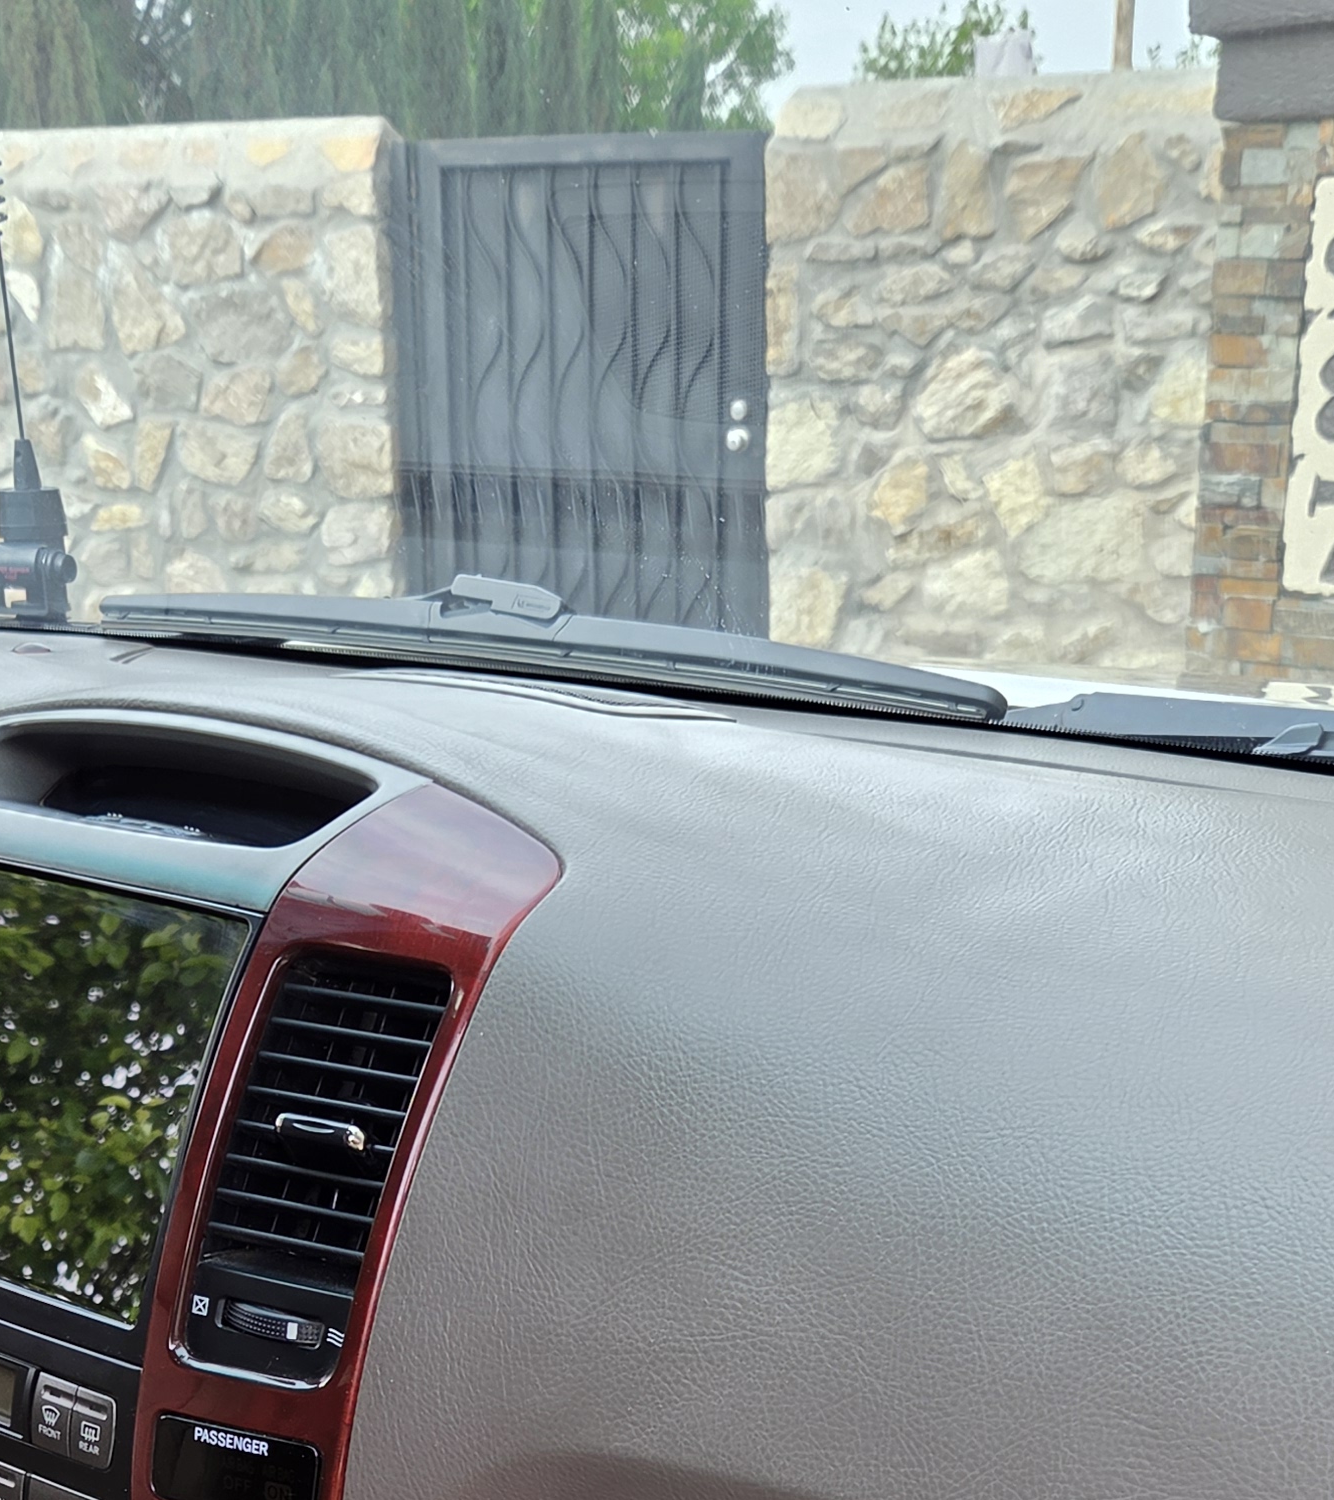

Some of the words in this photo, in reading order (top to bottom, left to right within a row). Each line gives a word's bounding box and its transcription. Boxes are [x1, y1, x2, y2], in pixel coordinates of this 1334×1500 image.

[38, 1424, 61, 1441] FRONT
[79, 1441, 100, 1456] REAR
[193, 1426, 269, 1457] PASSENGER
